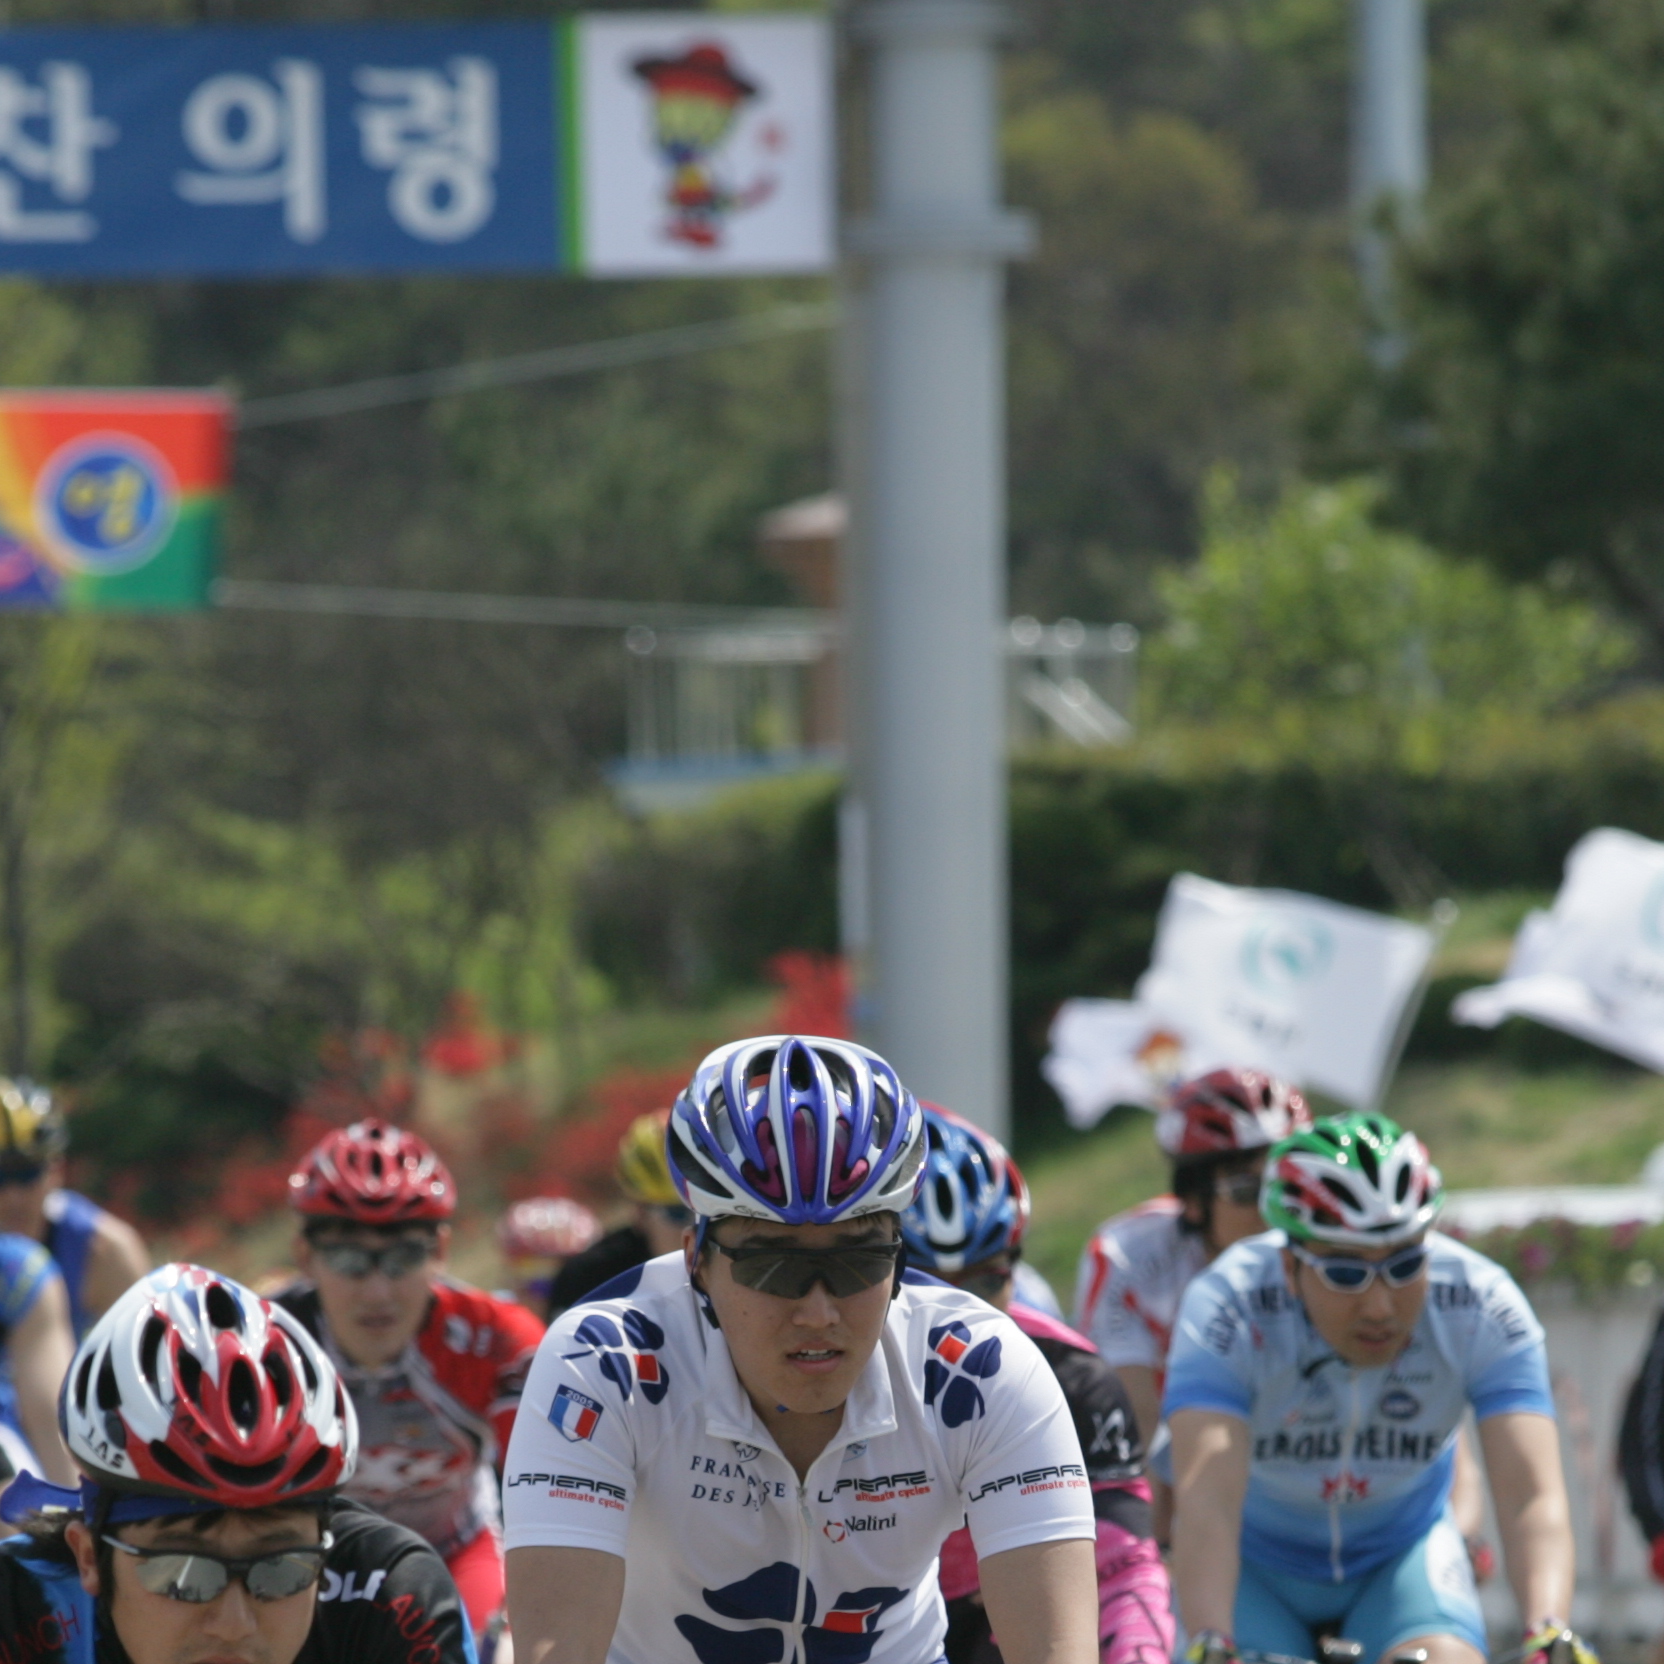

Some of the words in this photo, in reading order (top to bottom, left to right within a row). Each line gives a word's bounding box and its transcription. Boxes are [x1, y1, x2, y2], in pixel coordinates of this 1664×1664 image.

[176, 57, 503, 243] 의령
[565, 1388, 595, 1410] 2005
[507, 1473, 628, 1502] LAPIERRE
[691, 1483, 735, 1504] DES
[855, 1489, 896, 1503] ultimate
[898, 1484, 931, 1500] cycles
[1020, 1480, 1064, 1496] ultimate
[845, 1512, 897, 1536] Nalini
[318, 1568, 387, 1602] OLF
